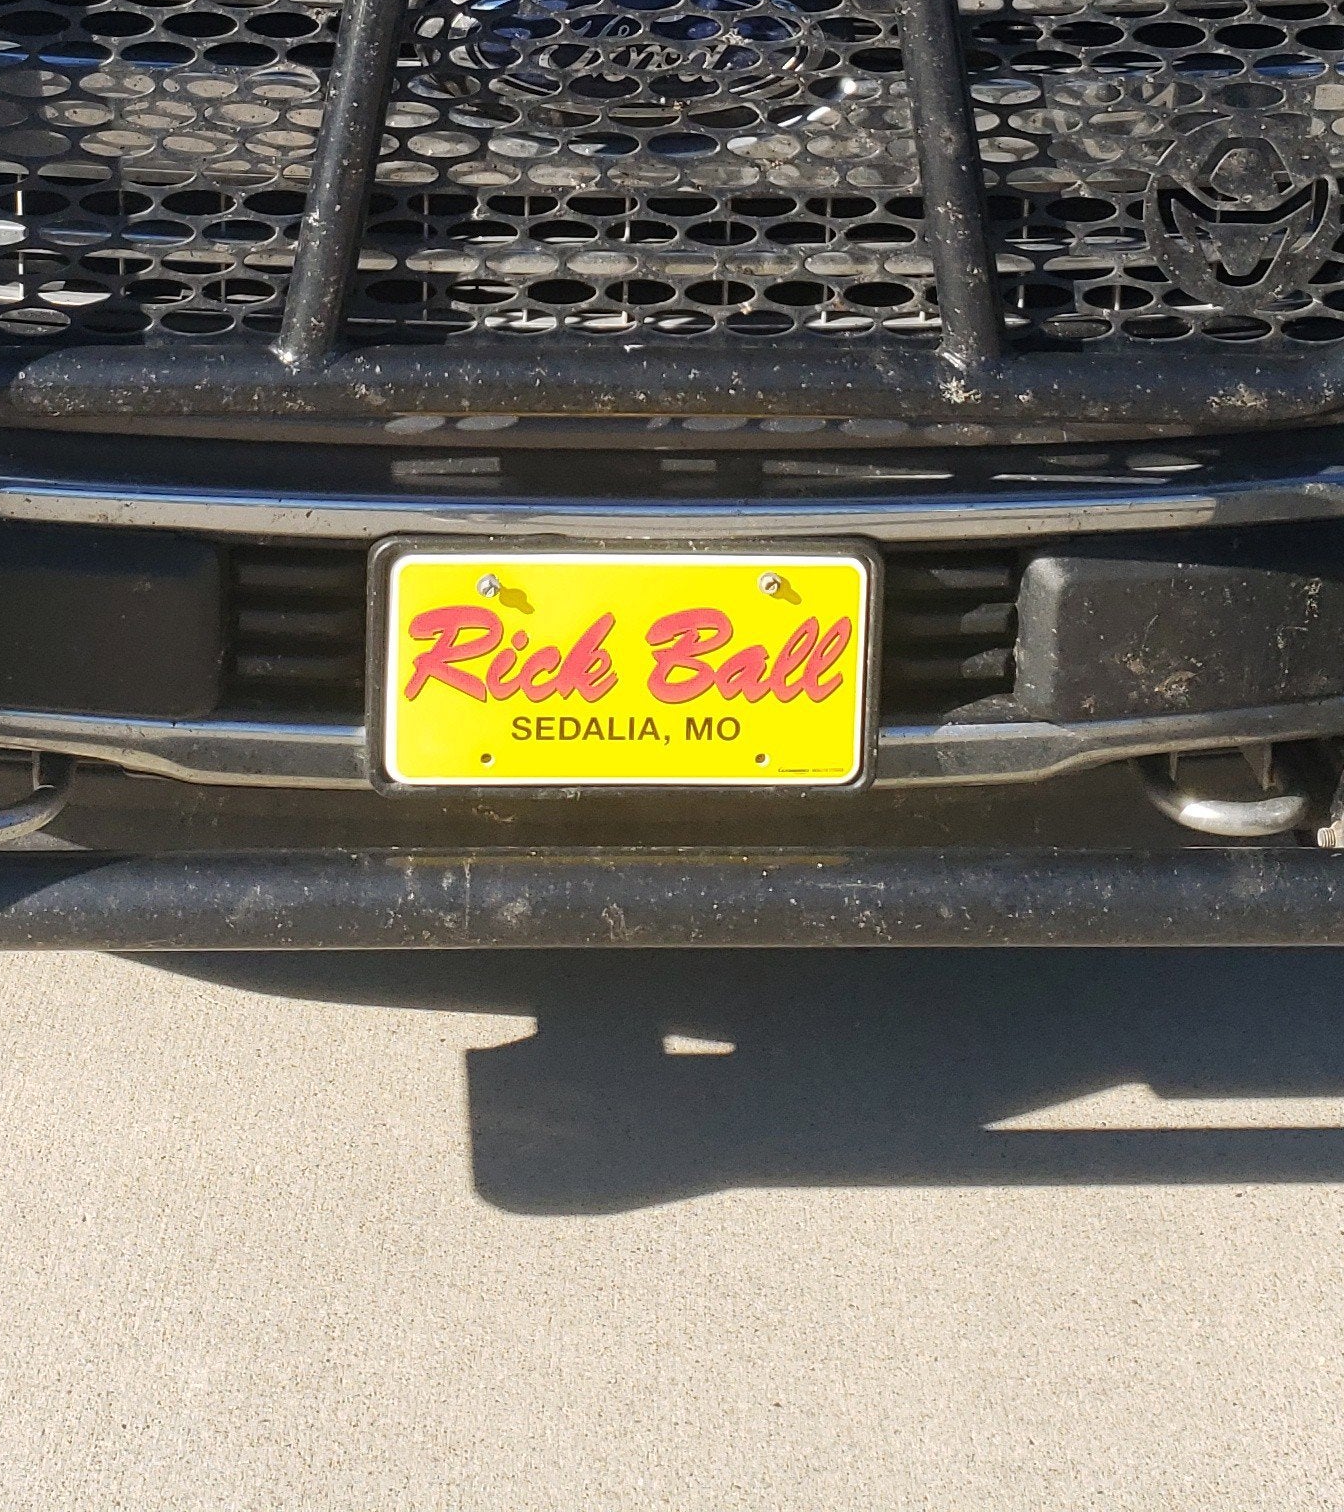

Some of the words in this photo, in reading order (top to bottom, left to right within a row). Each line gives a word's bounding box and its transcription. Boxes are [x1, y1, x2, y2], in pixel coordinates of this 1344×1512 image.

[404, 605, 618, 703] Rick
[645, 608, 852, 704] Ball
[512, 716, 670, 745] SEDALIA,
[686, 717, 740, 741] MO
